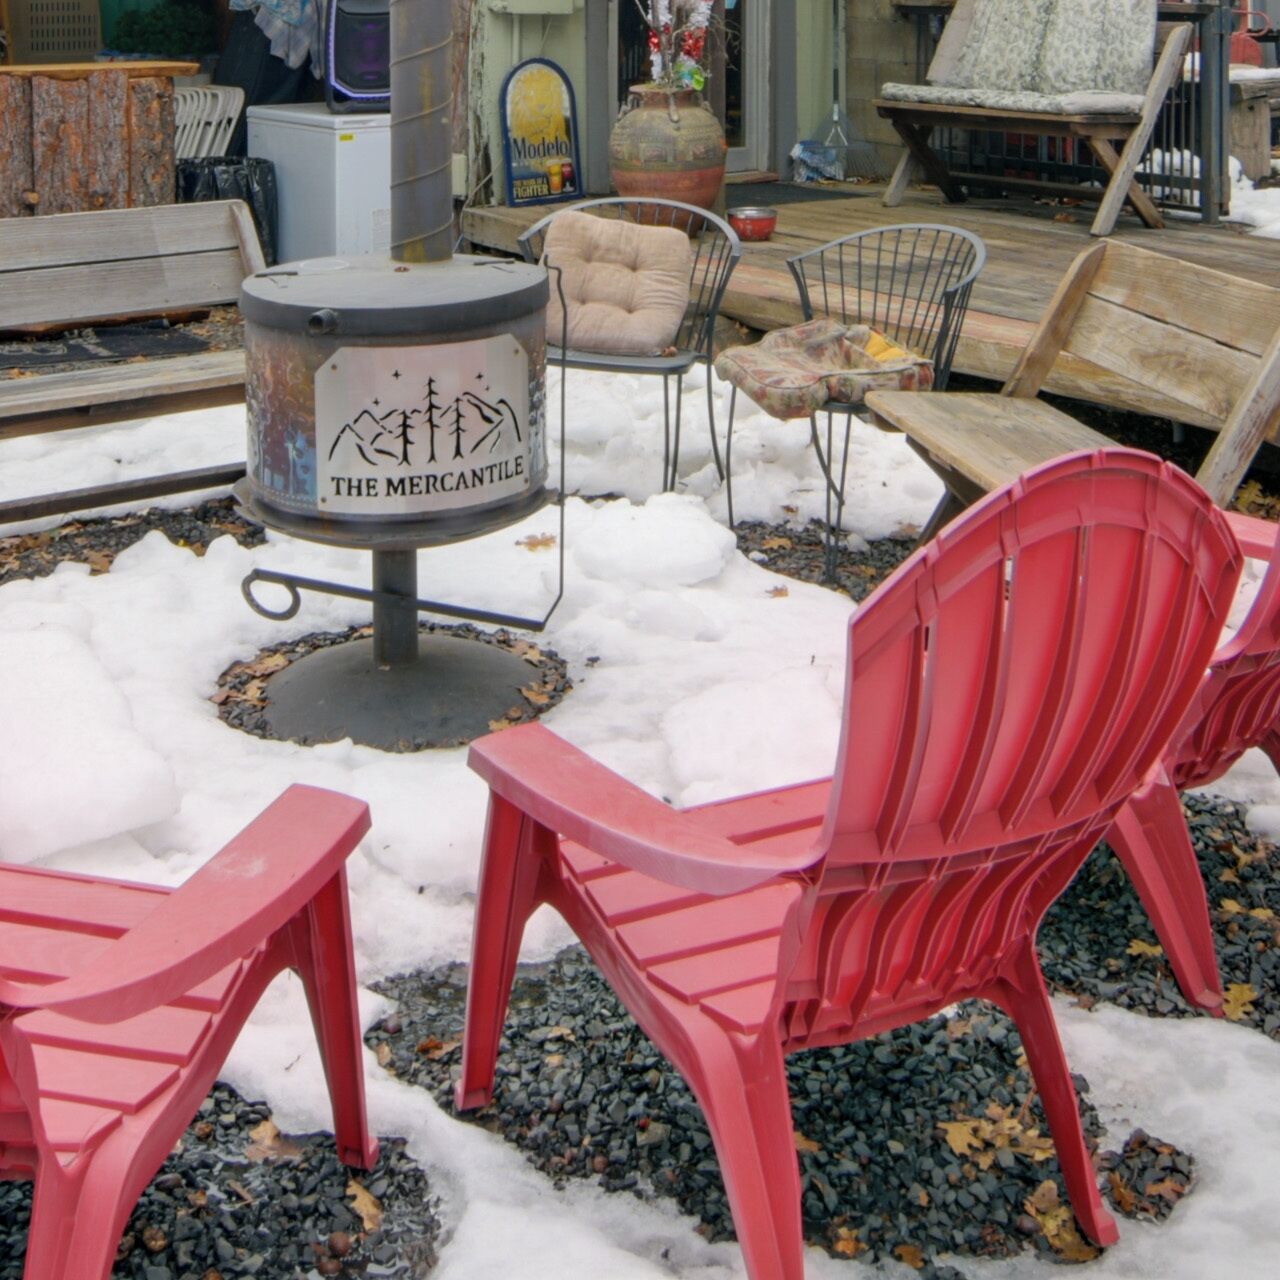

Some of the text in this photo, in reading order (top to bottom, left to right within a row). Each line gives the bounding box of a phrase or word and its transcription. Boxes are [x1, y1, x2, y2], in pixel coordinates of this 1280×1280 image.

[512, 136, 569, 161] Modelo
[331, 455, 524, 497] THE MERCANTILE
